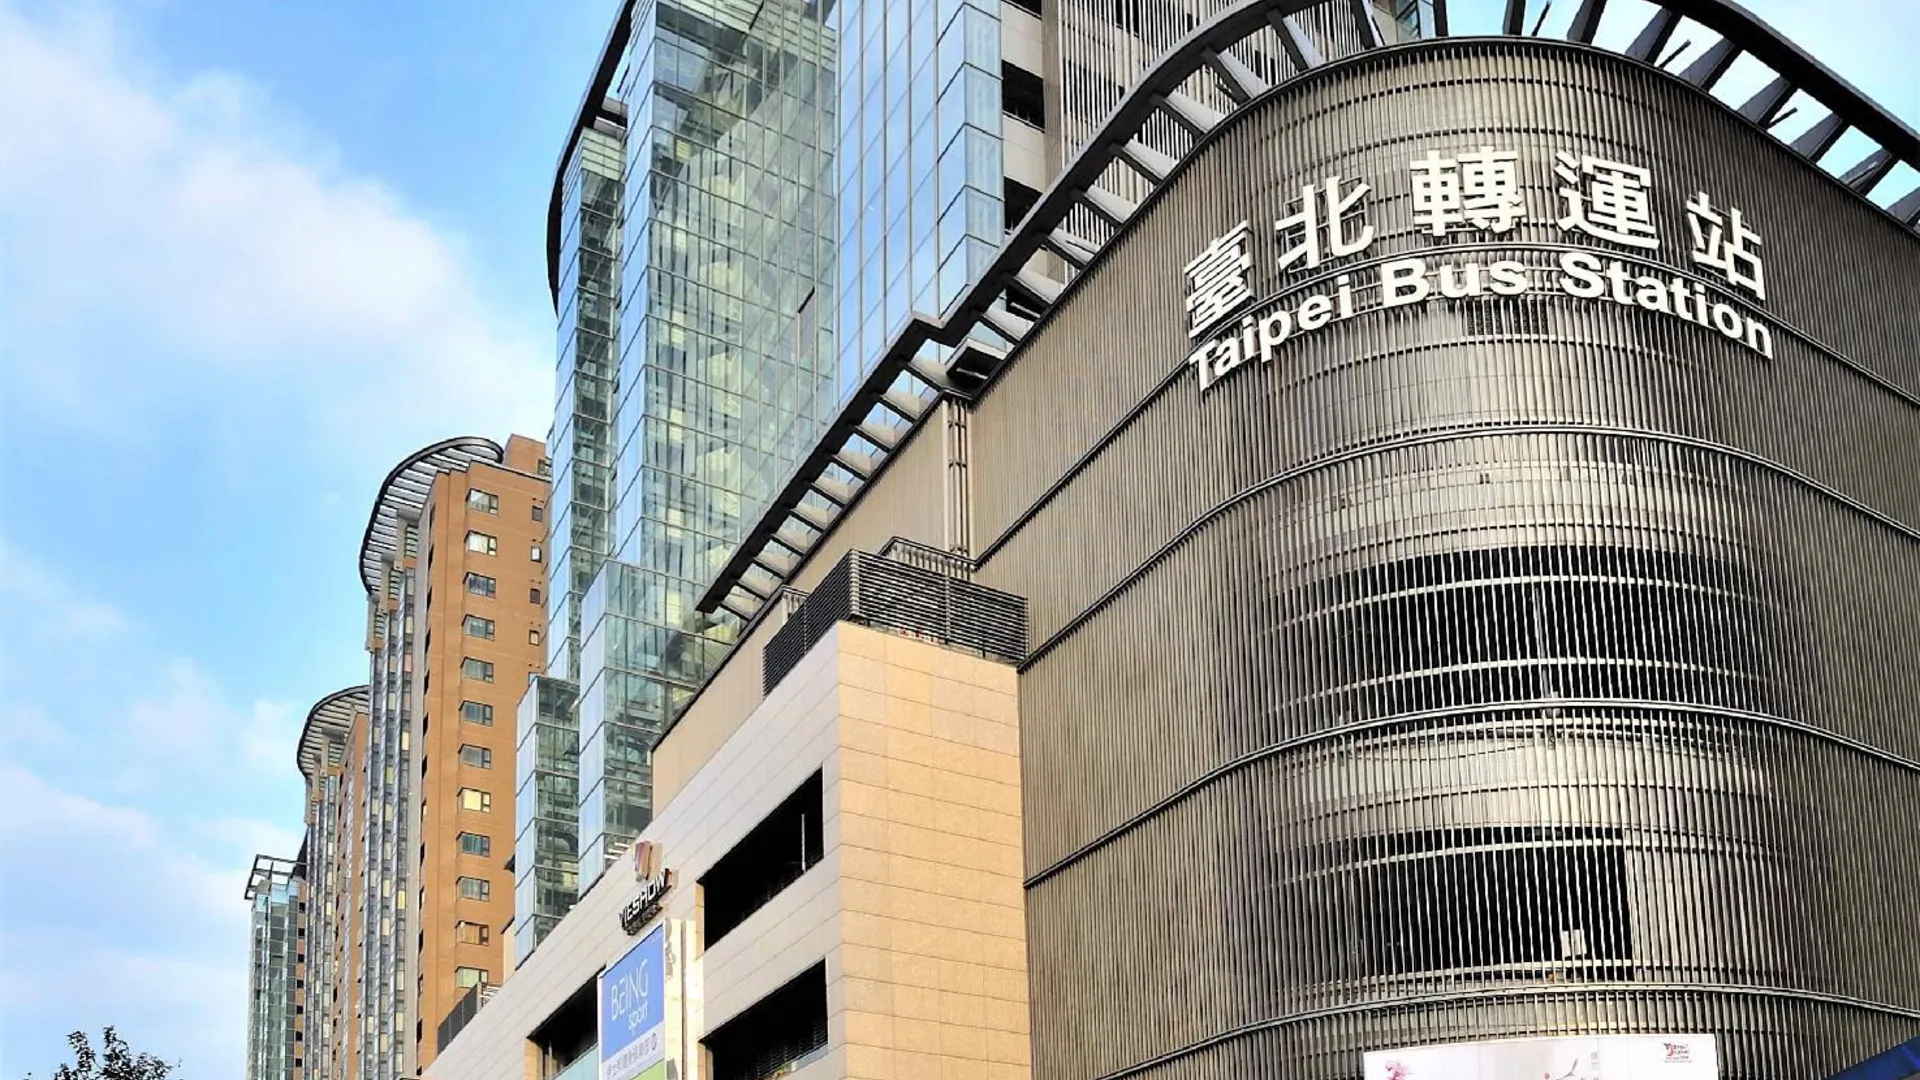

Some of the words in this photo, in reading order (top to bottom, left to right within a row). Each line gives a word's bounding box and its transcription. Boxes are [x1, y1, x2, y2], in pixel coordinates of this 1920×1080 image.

[1185, 147, 1766, 337] 臺北轉運站
[1189, 274, 1352, 392] Taipei
[1382, 259, 1529, 305] Bus
[1560, 253, 1773, 359] Station
[611, 959, 649, 1020] BEING
[628, 1000, 648, 1036] sport
